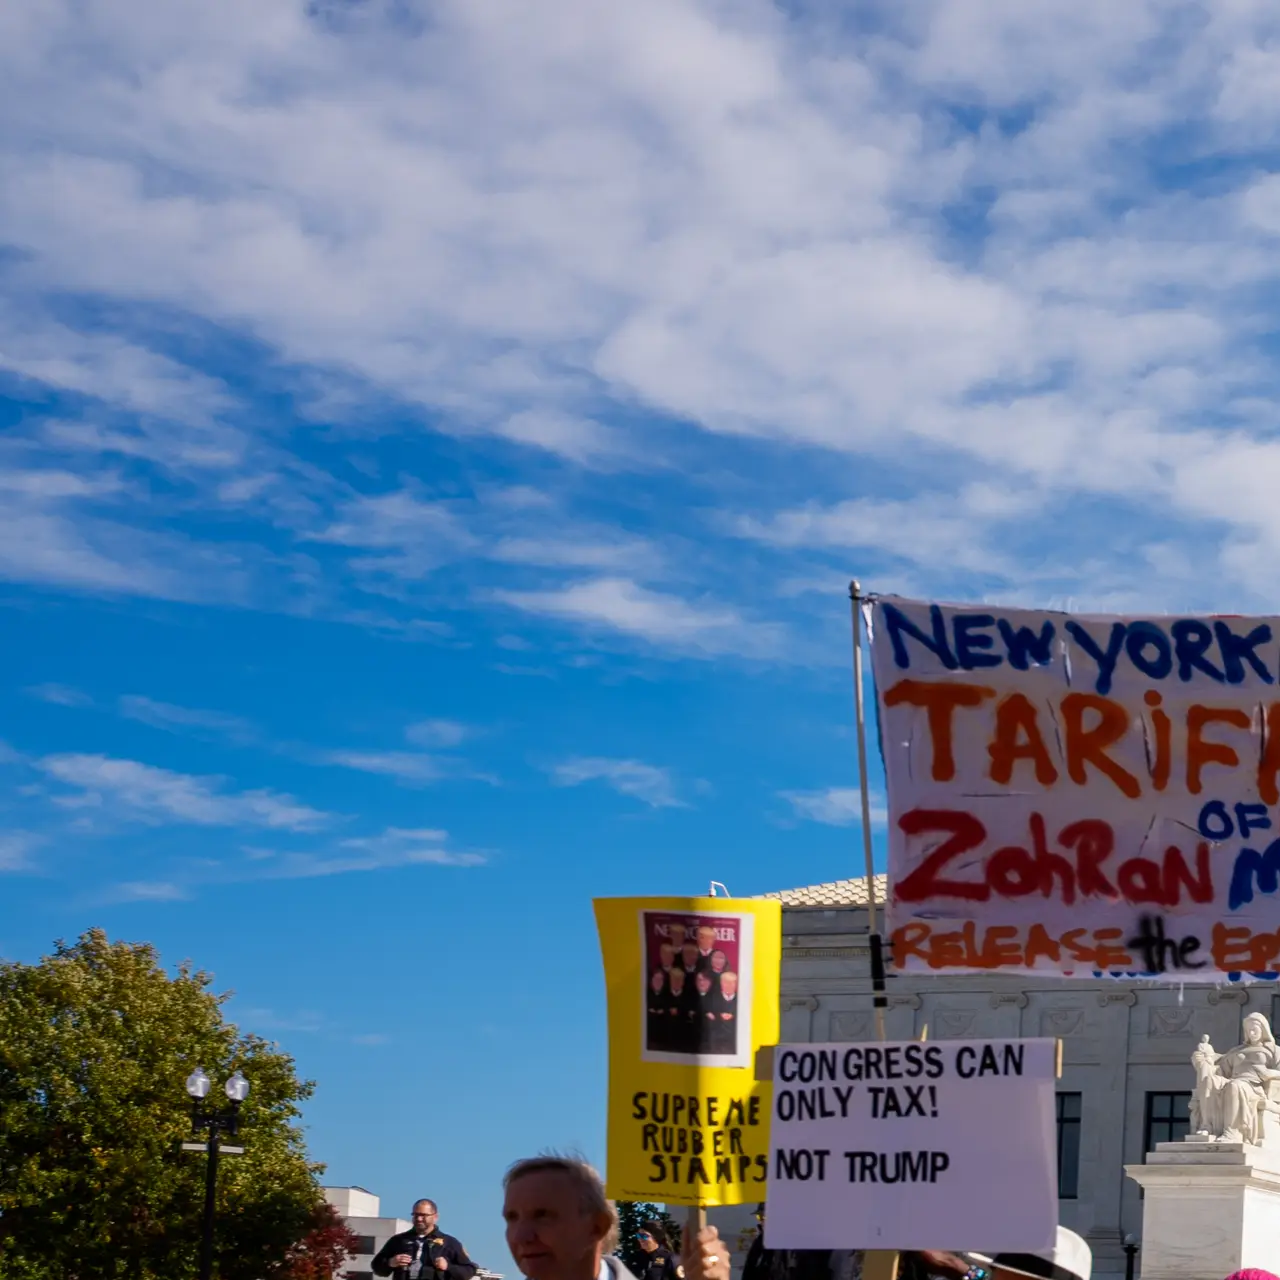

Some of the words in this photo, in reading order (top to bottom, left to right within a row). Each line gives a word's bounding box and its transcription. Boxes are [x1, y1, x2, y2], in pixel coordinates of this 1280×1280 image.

[882, 601, 1056, 670] NEW
[1065, 611, 1276, 694] YORK
[1199, 799, 1272, 839] OF
[1127, 912, 1207, 974] the
[778, 1044, 944, 1083] CONGRESS
[955, 1043, 1025, 1077] CAN
[632, 1091, 761, 1128] SUPREME
[776, 1087, 854, 1122] ONLY
[866, 1085, 939, 1118] TAX!
[642, 1123, 745, 1157] RUBBER
[648, 1154, 768, 1184] STAMPS
[775, 1149, 830, 1182] NOT
[844, 1151, 950, 1184] TRUMP
